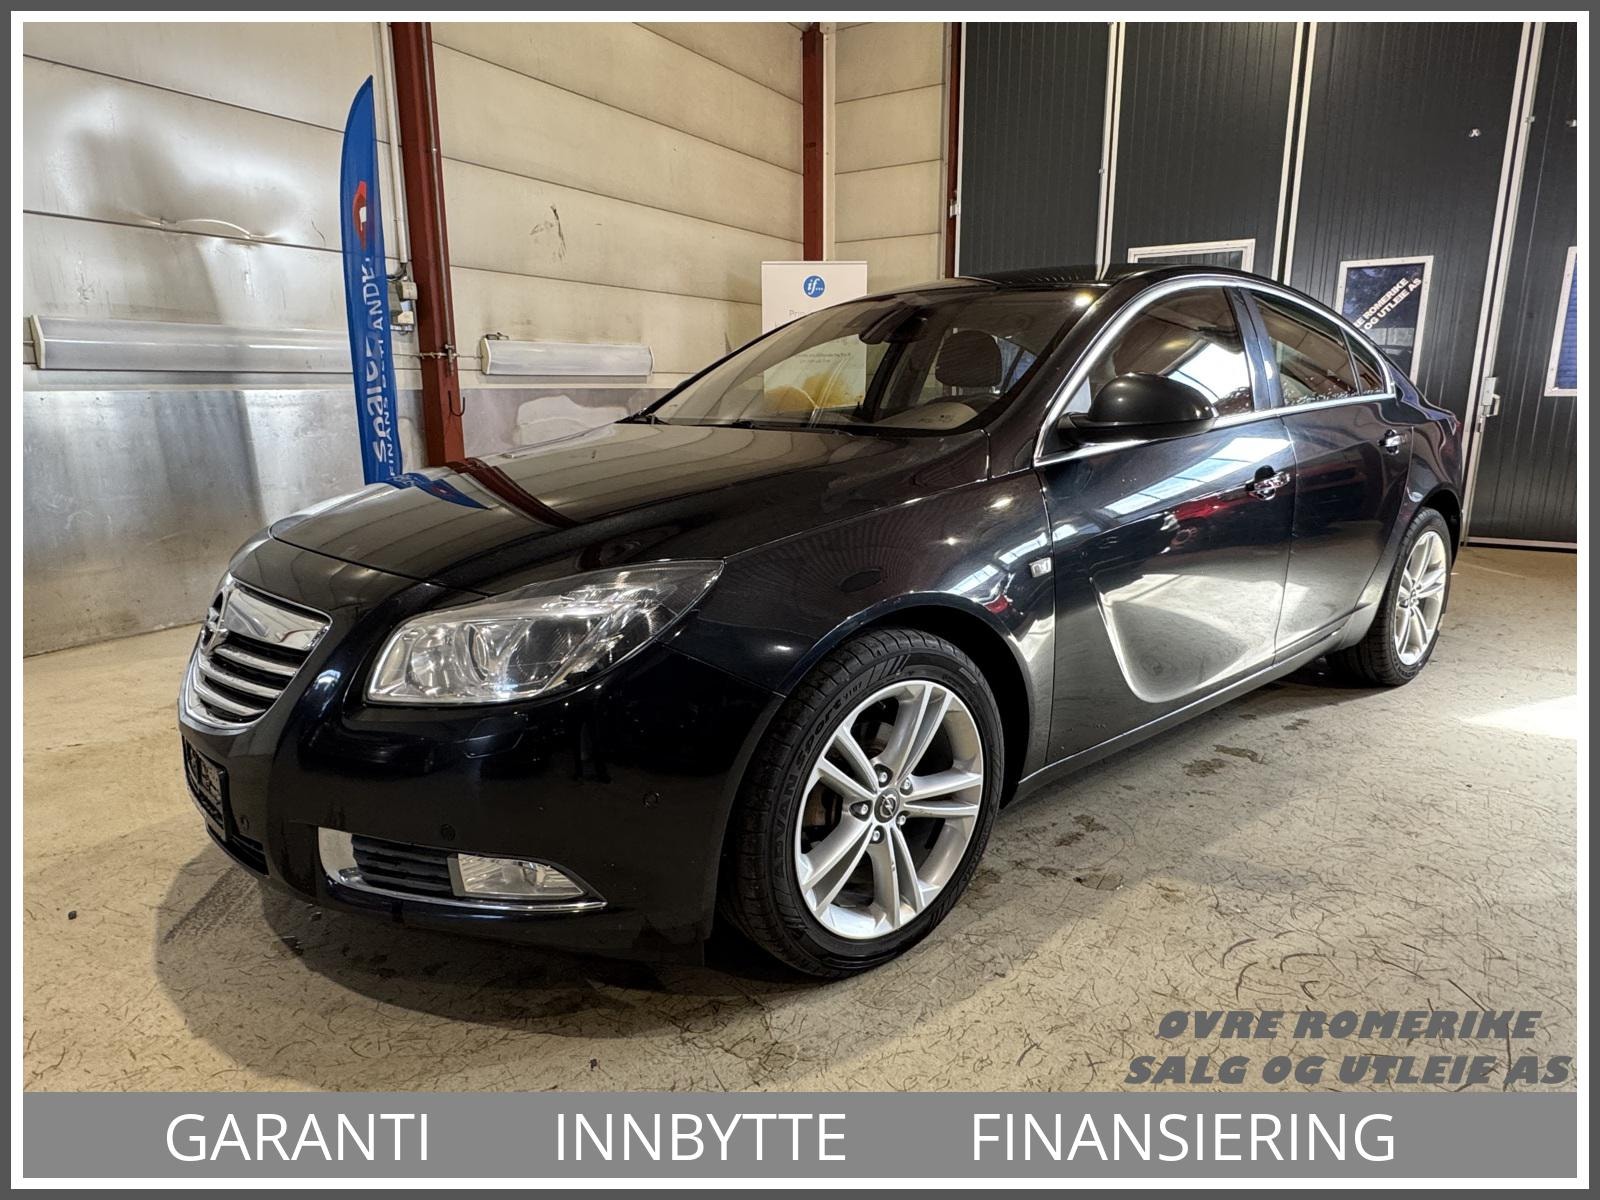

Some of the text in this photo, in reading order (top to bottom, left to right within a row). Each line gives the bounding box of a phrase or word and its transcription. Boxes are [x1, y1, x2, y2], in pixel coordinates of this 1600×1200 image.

[1362, 277, 1409, 320] ROMERIKE
[1363, 277, 1422, 330] OG UTLEIE AS
